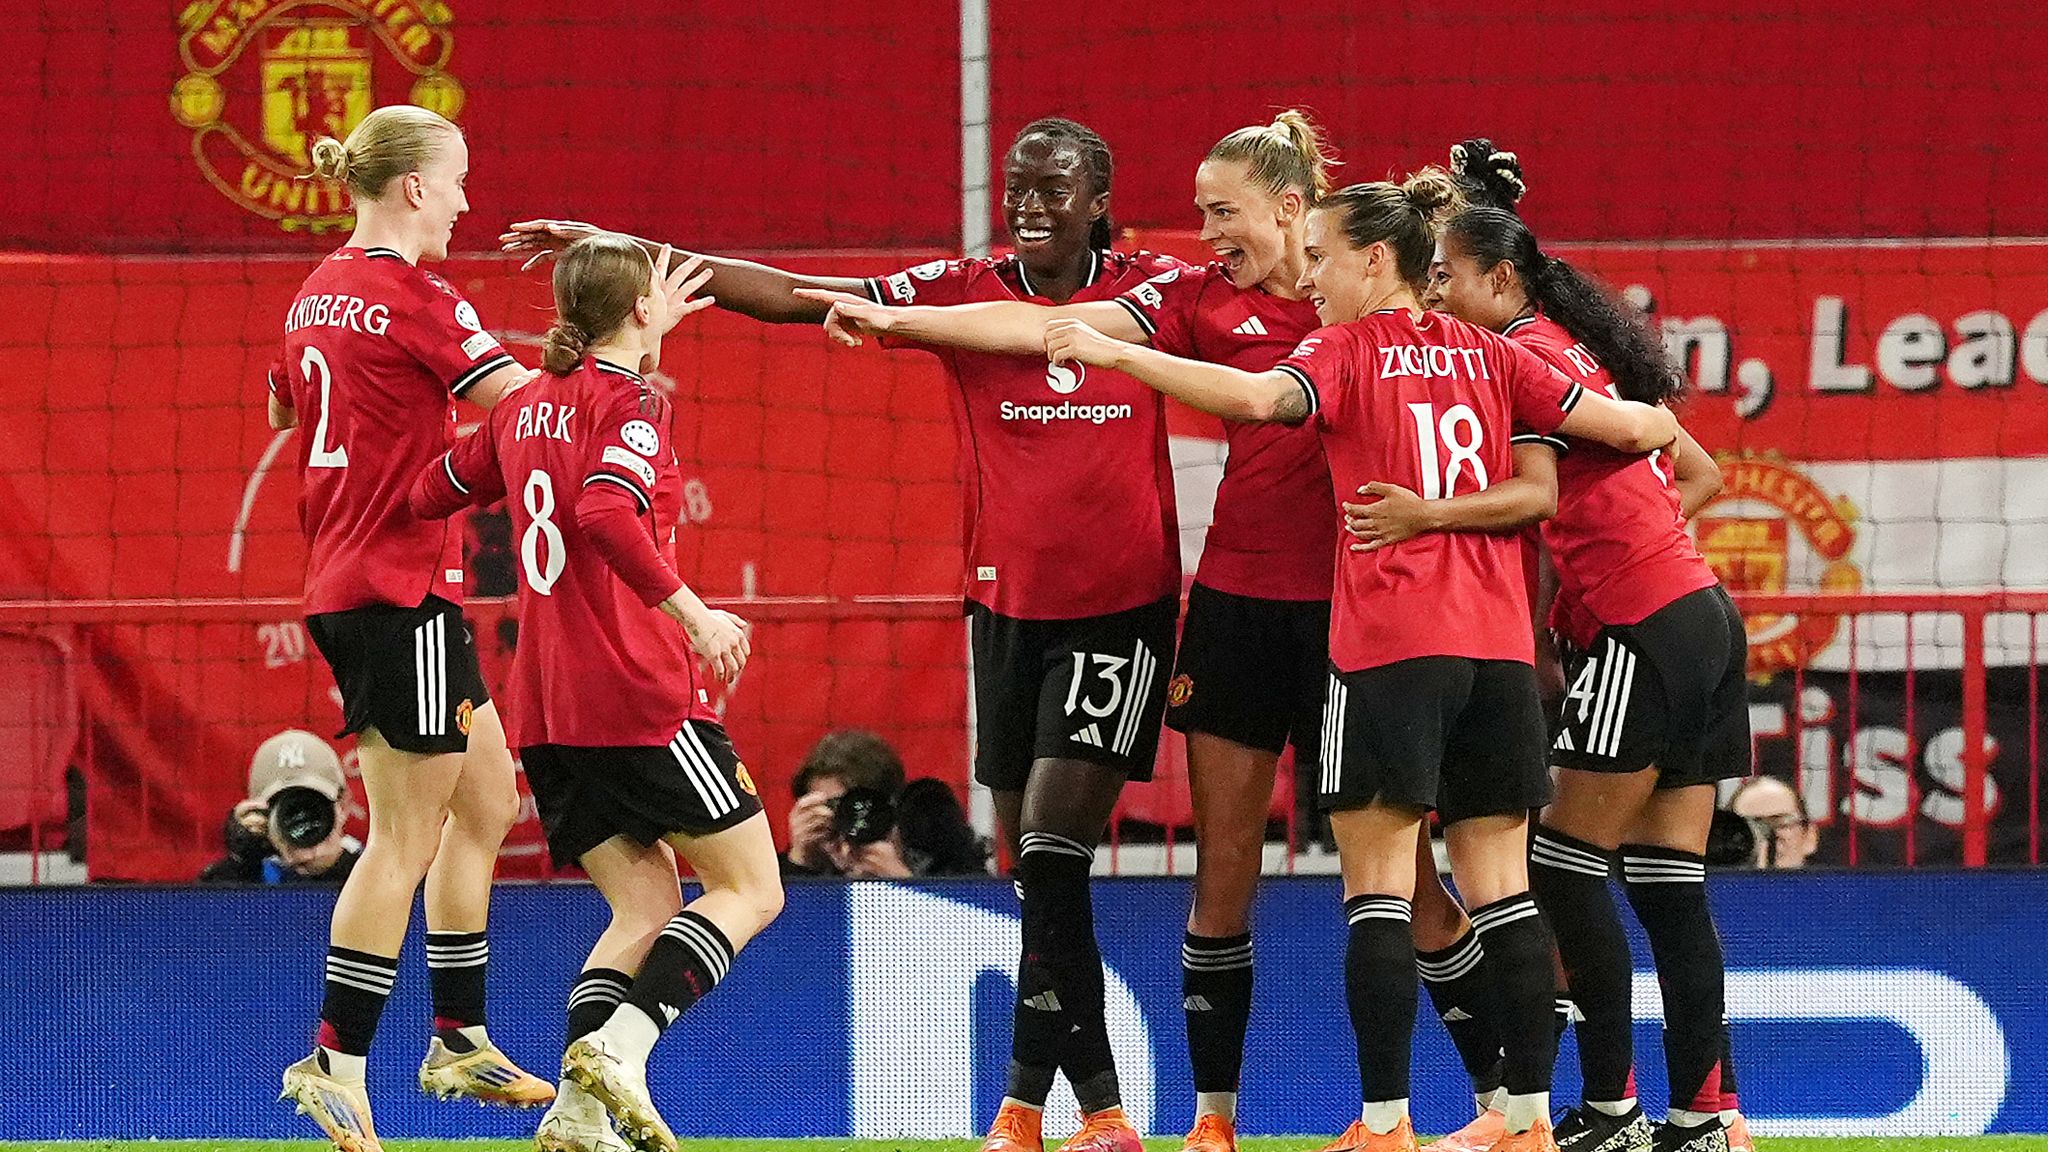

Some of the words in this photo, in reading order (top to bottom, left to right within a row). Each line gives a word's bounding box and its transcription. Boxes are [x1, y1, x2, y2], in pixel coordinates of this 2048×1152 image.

[1378, 344, 1490, 381] ZIGIOTTI
[300, 345, 349, 468] 2
[515, 401, 576, 443] PARK
[1000, 401, 1132, 425] Snapdragon
[1407, 402, 1489, 499] 18
[520, 469, 567, 596] 8
[1064, 651, 1129, 718] 13
[1561, 657, 1598, 724] 4
